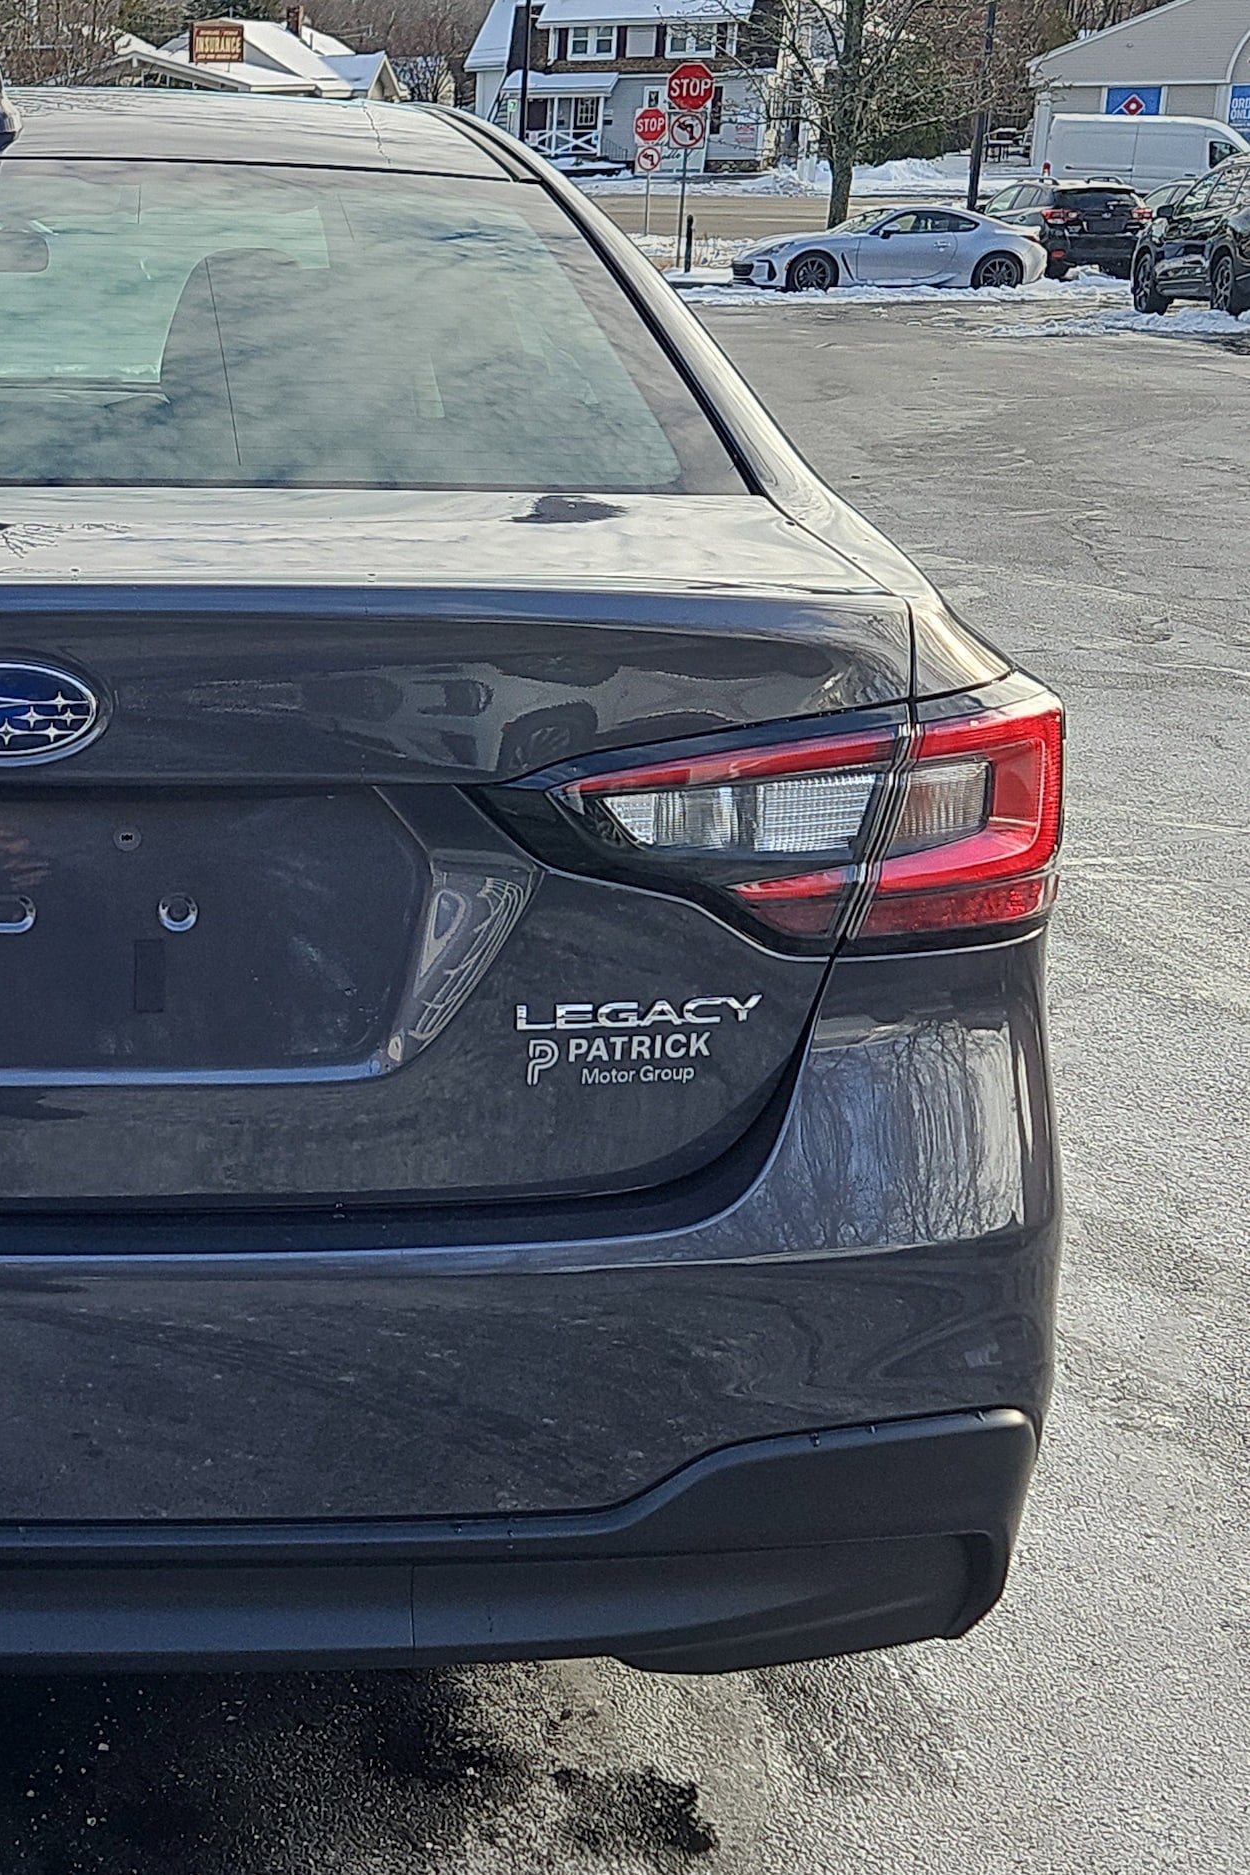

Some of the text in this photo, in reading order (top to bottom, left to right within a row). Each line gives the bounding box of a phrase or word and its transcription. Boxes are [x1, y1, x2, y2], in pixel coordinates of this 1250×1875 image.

[196, 36, 241, 53] INSURANCE
[670, 78, 710, 97] STOP
[636, 117, 665, 133] STOP
[515, 994, 763, 1031] LEGACY
[567, 1031, 711, 1063] PATRICK
[580, 1065, 695, 1086] Motor Group
